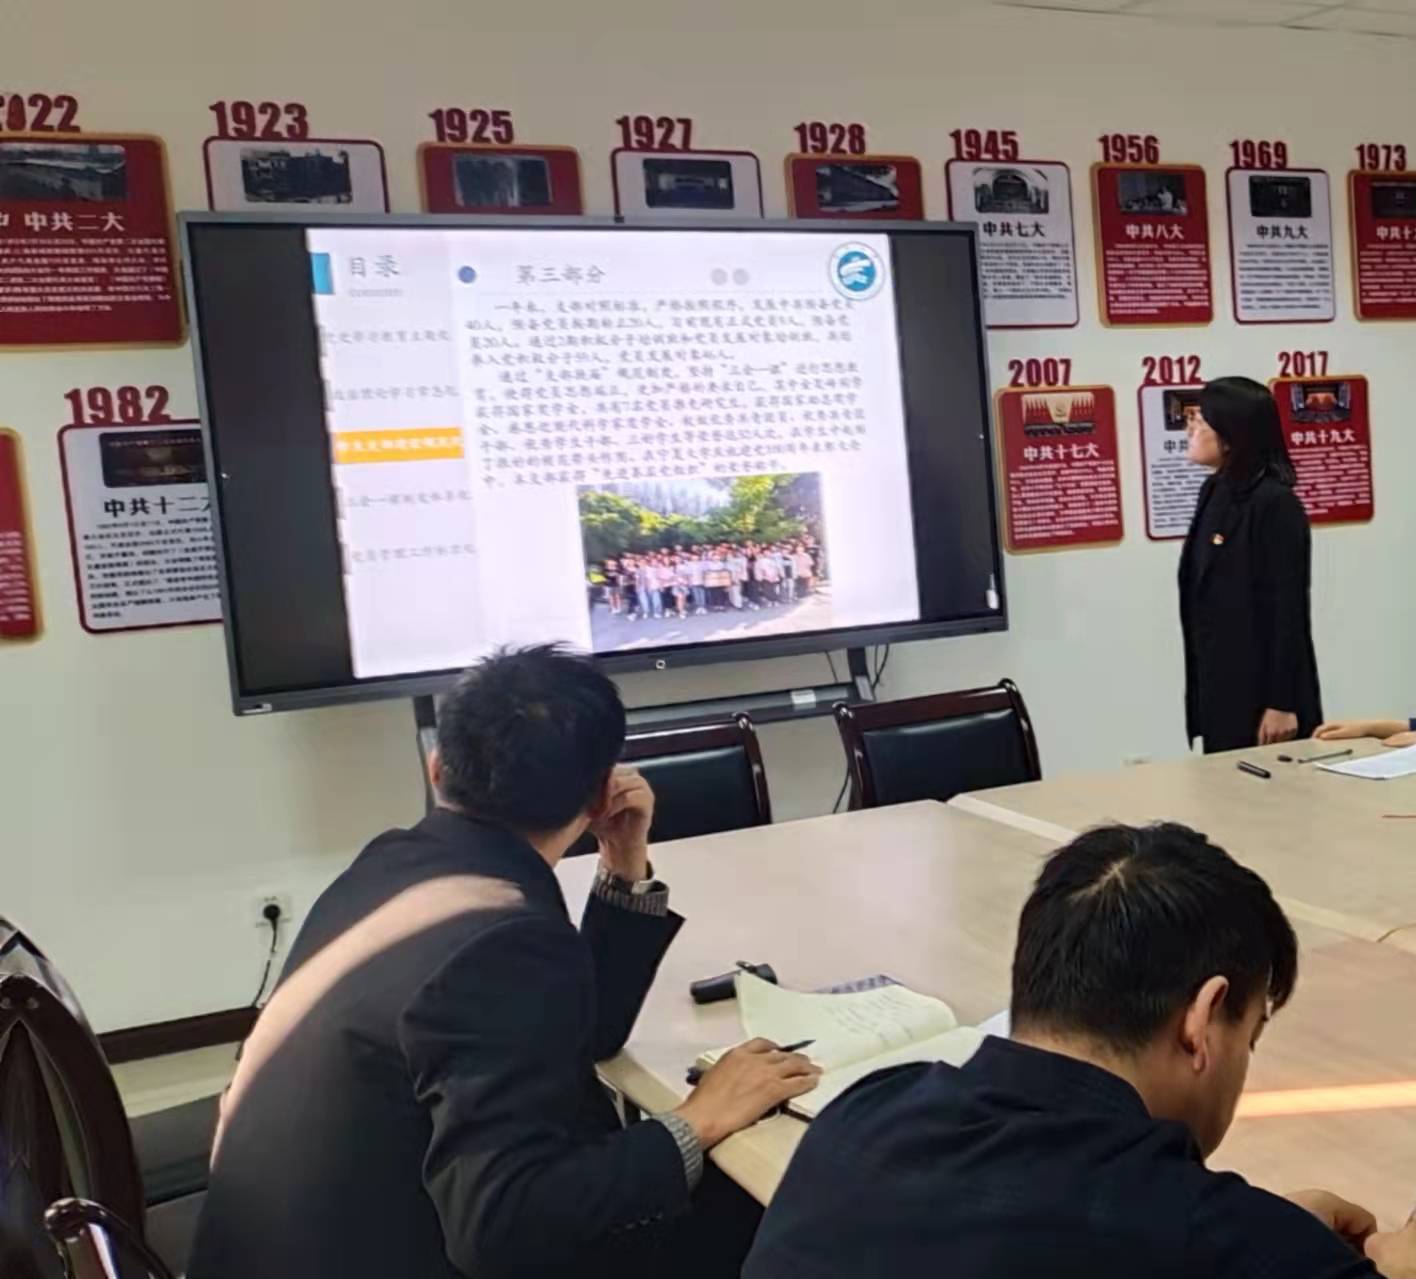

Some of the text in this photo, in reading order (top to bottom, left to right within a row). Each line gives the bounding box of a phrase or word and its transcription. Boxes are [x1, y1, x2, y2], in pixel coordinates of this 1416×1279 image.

[209, 101, 309, 139] 1923
[428, 108, 515, 144] 1925
[616, 116, 692, 150] 1927
[794, 122, 867, 155] 1928
[949, 129, 1019, 161] 1945
[1098, 134, 1160, 164] 1956
[1229, 140, 1288, 169] 1969
[1355, 143, 1407, 171] 1973
[24, 211, 125, 232] 中共二大
[983, 221, 1046, 238] 中共七大
[1125, 223, 1185, 240] 中共八大
[1256, 225, 1310, 239] 中共九大
[350, 254, 400, 278] 目录
[516, 264, 606, 285] 第三部分
[1008, 358, 1072, 387] 2007
[1142, 355, 1201, 384] 2012
[1278, 351, 1329, 377] 2017
[64, 385, 171, 424] 1982
[1290, 429, 1355, 445] 中共十九大
[1023, 442, 1099, 461] 中共十七大
